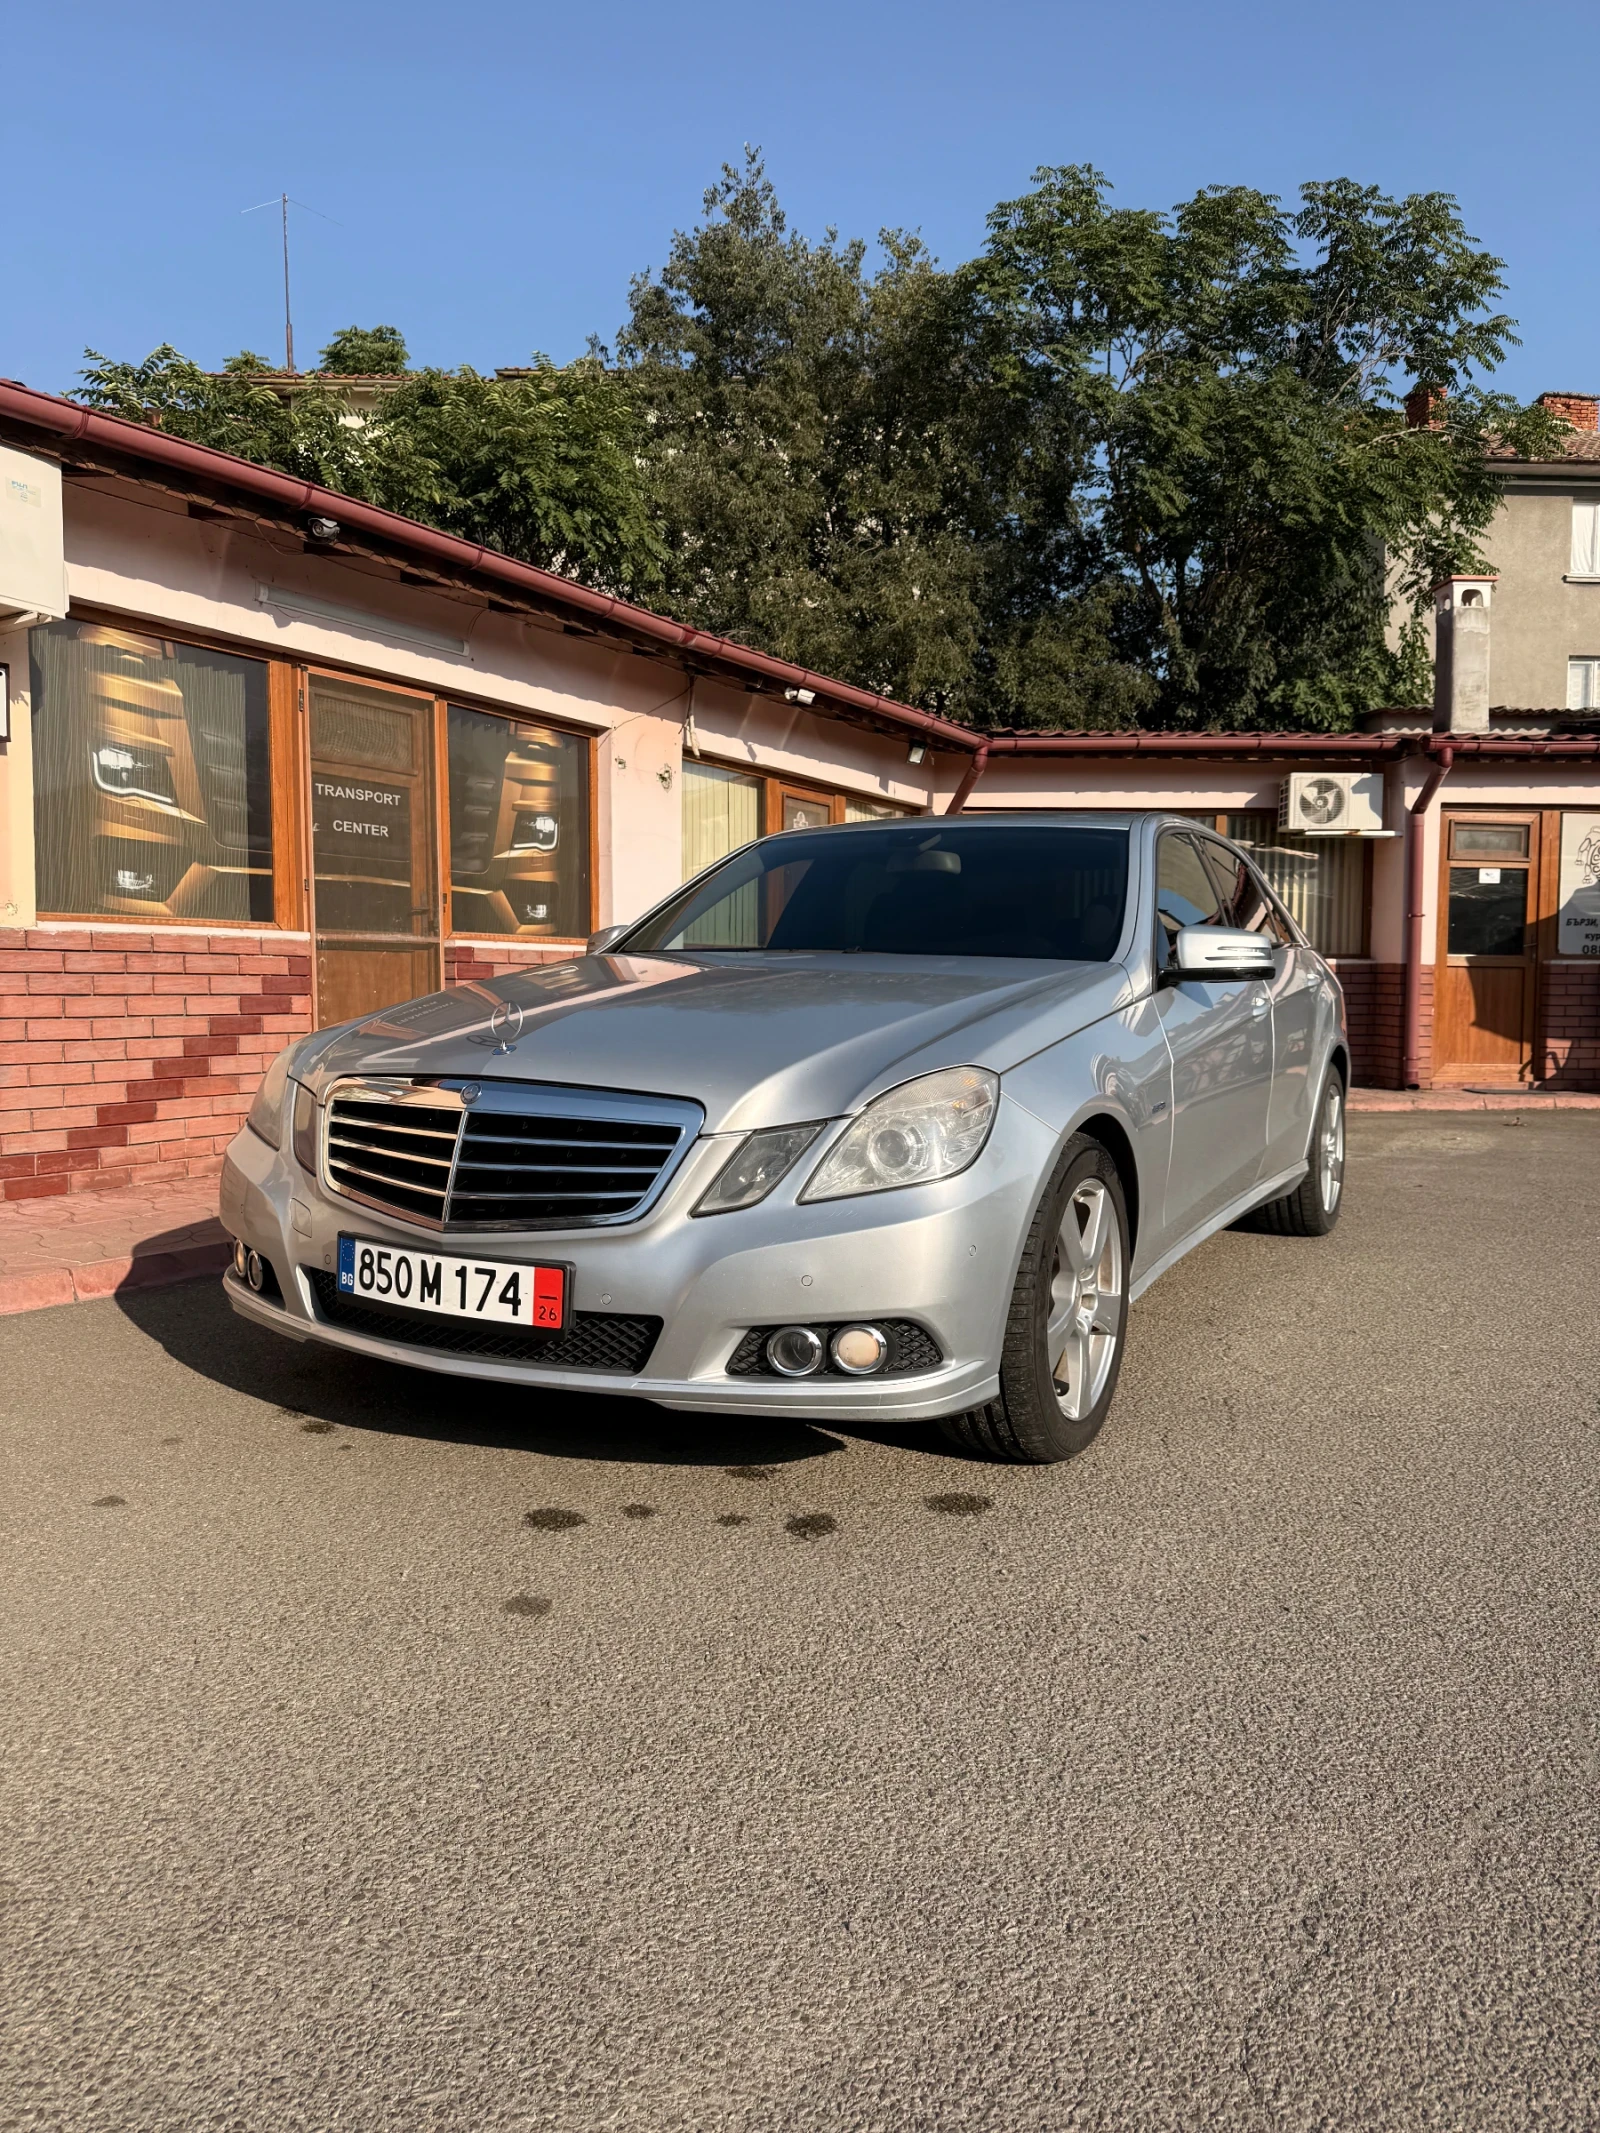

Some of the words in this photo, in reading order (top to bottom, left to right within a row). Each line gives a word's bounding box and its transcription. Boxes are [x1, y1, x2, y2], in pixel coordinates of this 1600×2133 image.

[315, 783, 401, 806] TRANSPORT
[333, 820, 389, 837] CENTER
[341, 1271, 354, 1286] BG
[358, 1248, 413, 1299] 850
[420, 1259, 442, 1306] M
[455, 1265, 522, 1317] 174
[538, 1305, 557, 1321] 26
